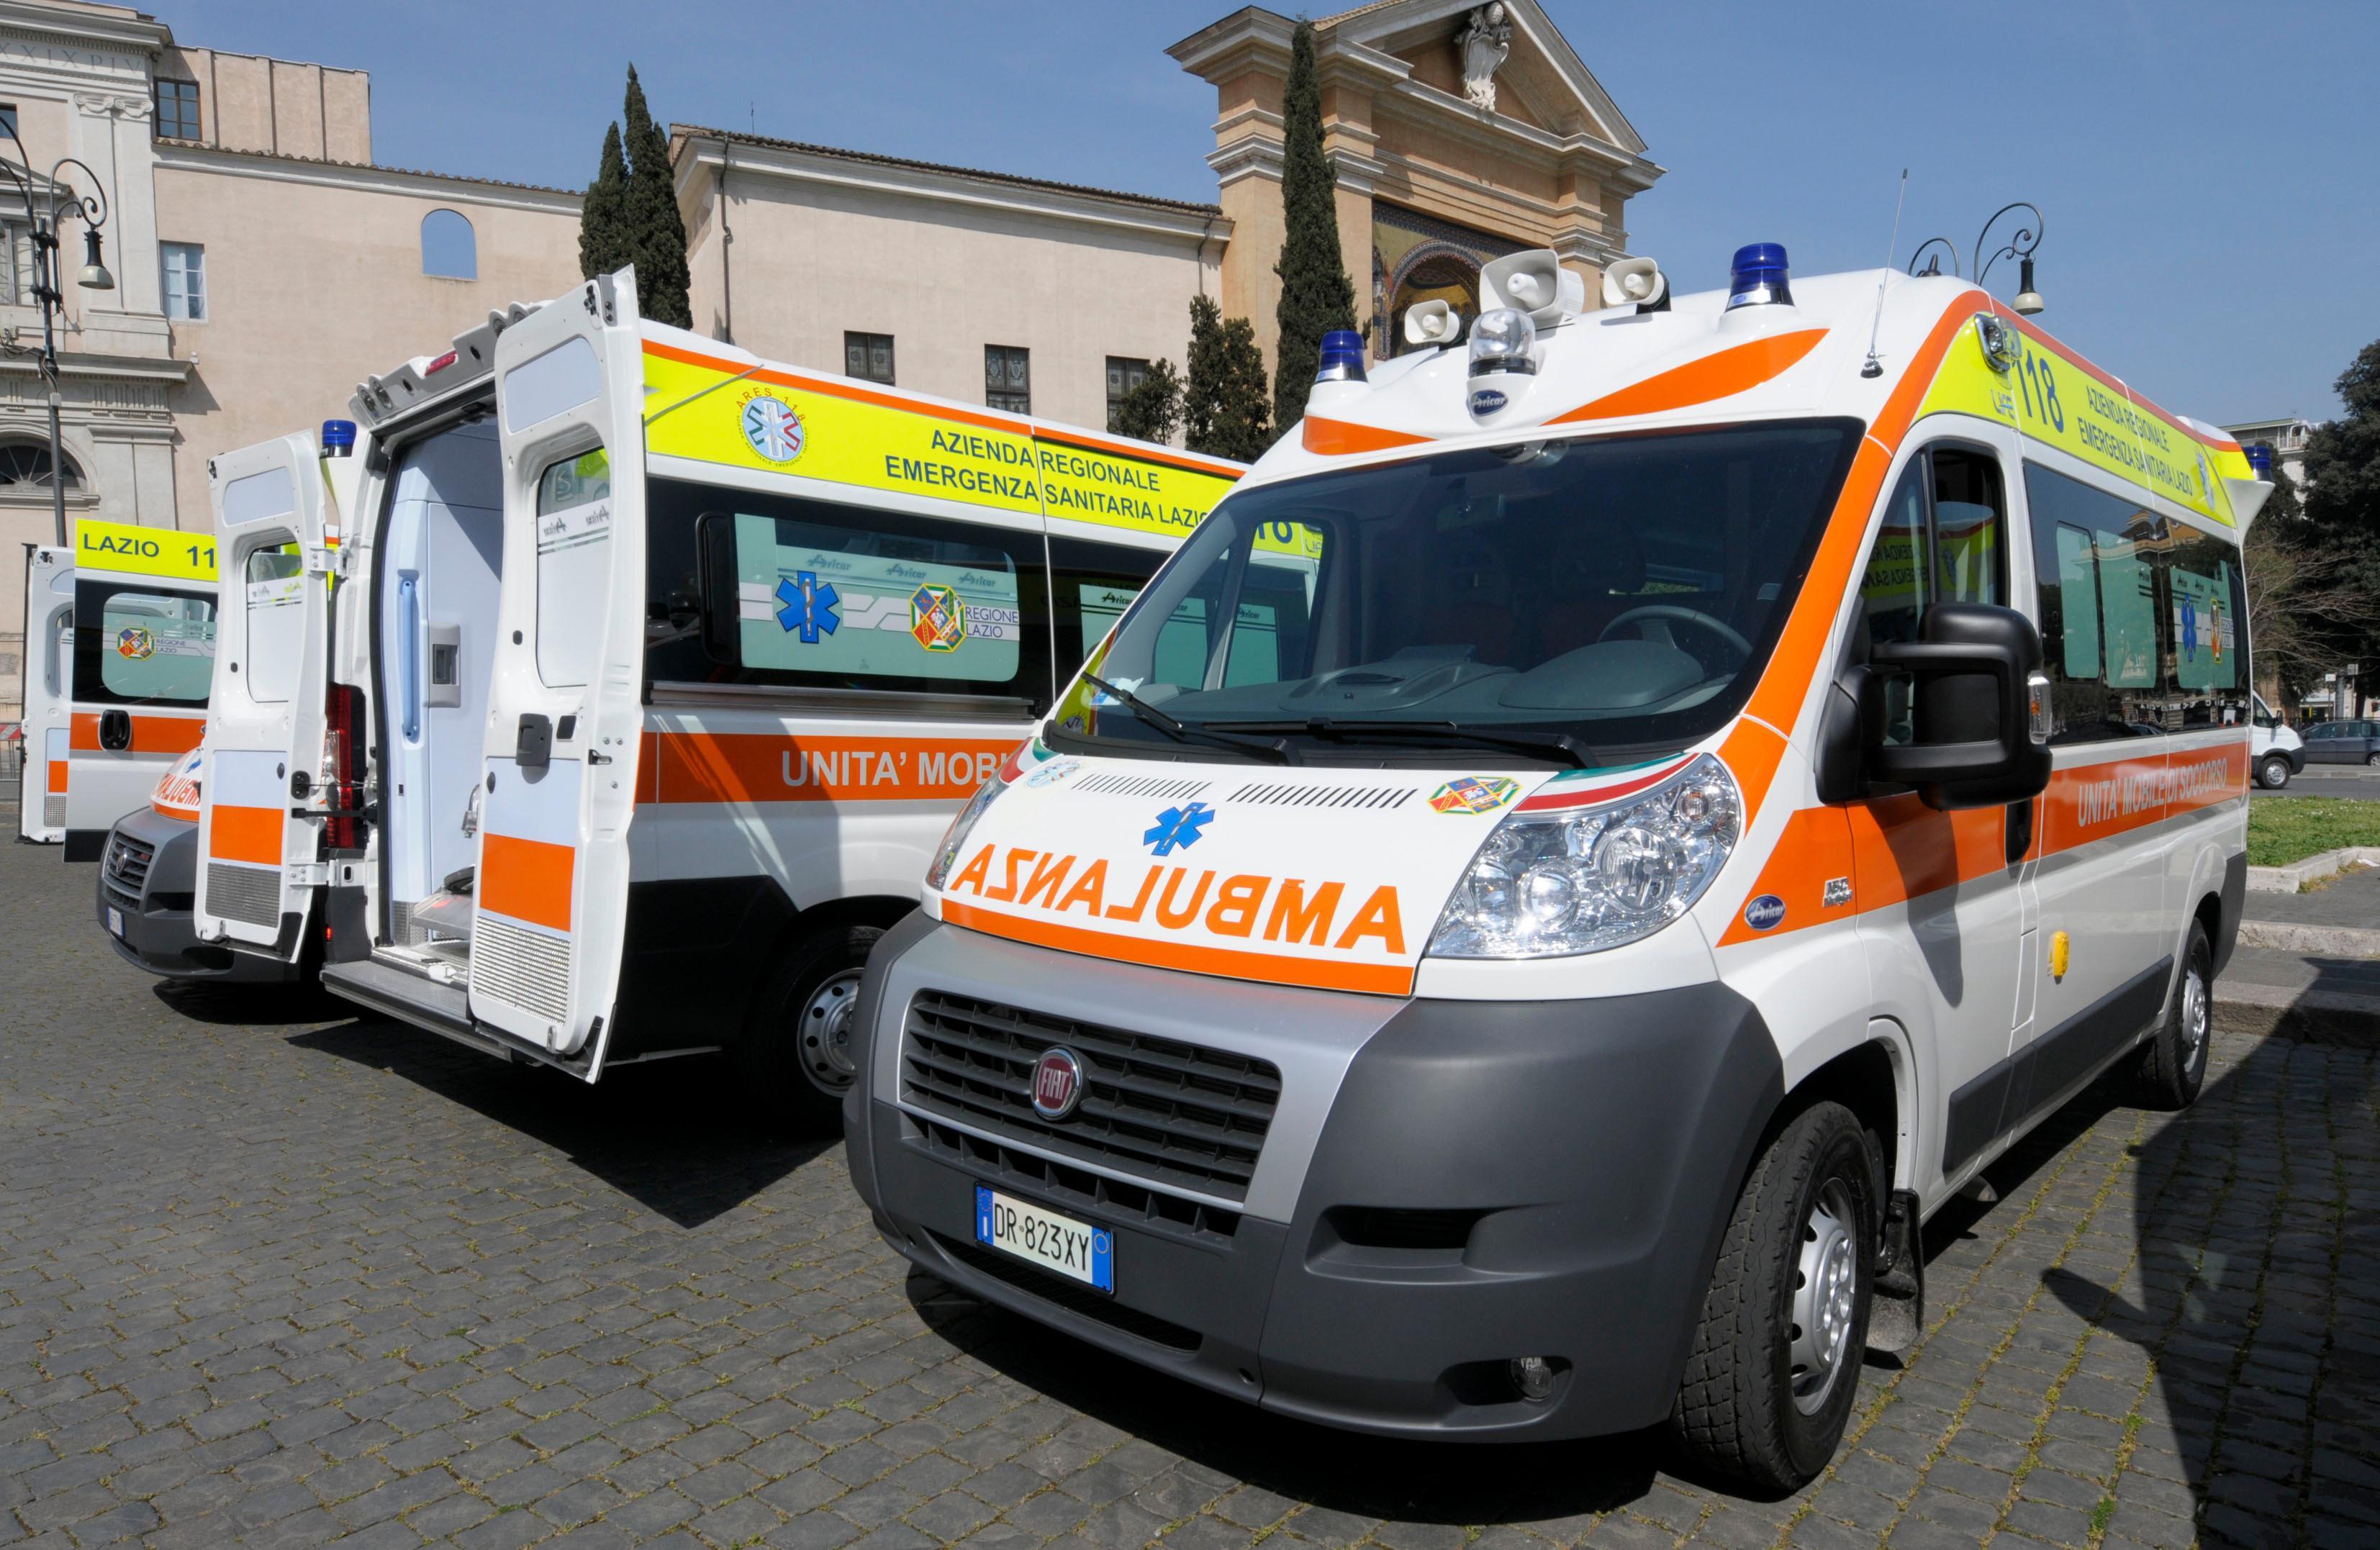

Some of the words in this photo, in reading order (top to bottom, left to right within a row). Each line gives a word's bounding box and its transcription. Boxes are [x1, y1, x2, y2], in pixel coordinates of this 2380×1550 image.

[736, 387, 772, 410] ARES
[784, 396, 806, 421] 118
[2013, 349, 2064, 433] 118
[2086, 385, 2127, 429] AZIENDA
[2124, 408, 2171, 453] REGIONALE
[931, 430, 1036, 468] AZIENDA
[1040, 450, 1161, 492] REGIONALE
[2078, 417, 2135, 468] EMERGENZA
[2134, 447, 2176, 488] SANITARIA
[2172, 468, 2193, 497] LAZIO
[885, 455, 1040, 502] EMERGENZA
[1045, 484, 1154, 521] SANITARIA
[83, 533, 159, 558] LAZIO
[186, 545, 214, 568] 11
[884, 563, 927, 579] Aricar
[958, 572, 996, 587] Aricar
[965, 607, 1019, 623] REGIONE
[967, 624, 1003, 638] LAZIO
[918, 752, 1008, 786] MOB
[2122, 769, 2165, 816] MOBILE
[2167, 767, 2178, 803] DI
[2180, 757, 2227, 800] SOCCORSO
[1748, 902, 1785, 923] Aricar
[1040, 1066, 1069, 1100] FIAT
